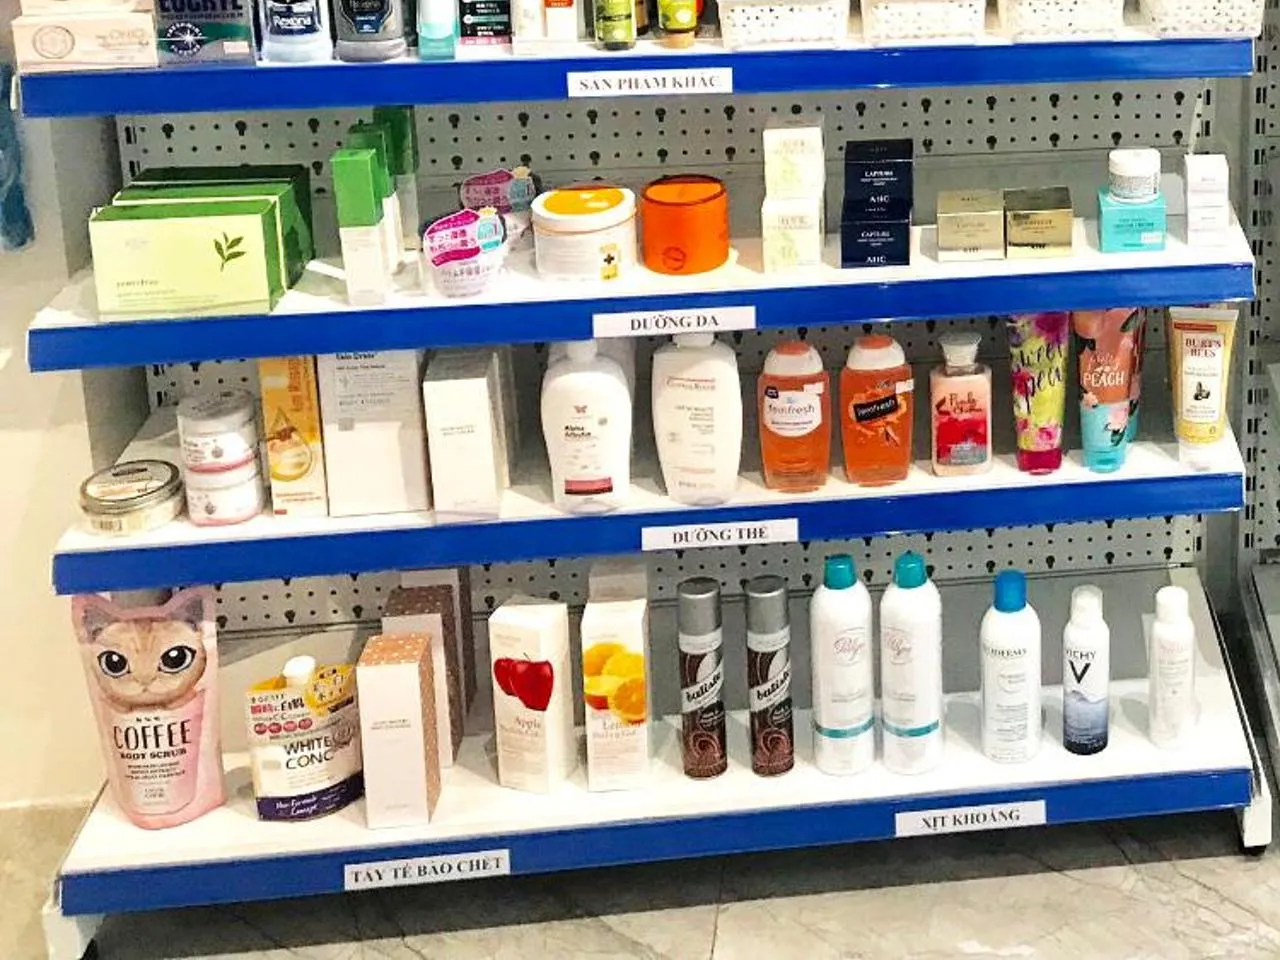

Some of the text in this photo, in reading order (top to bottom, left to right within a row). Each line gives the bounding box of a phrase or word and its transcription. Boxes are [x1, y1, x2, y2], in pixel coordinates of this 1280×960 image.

[696, 314, 720, 328] DA
[1082, 372, 1125, 387] PEACH
[113, 718, 193, 751] COFFEE
[283, 733, 334, 755] WHITE
[149, 747, 188, 759] SCRUB
[286, 751, 336, 770] CONC
